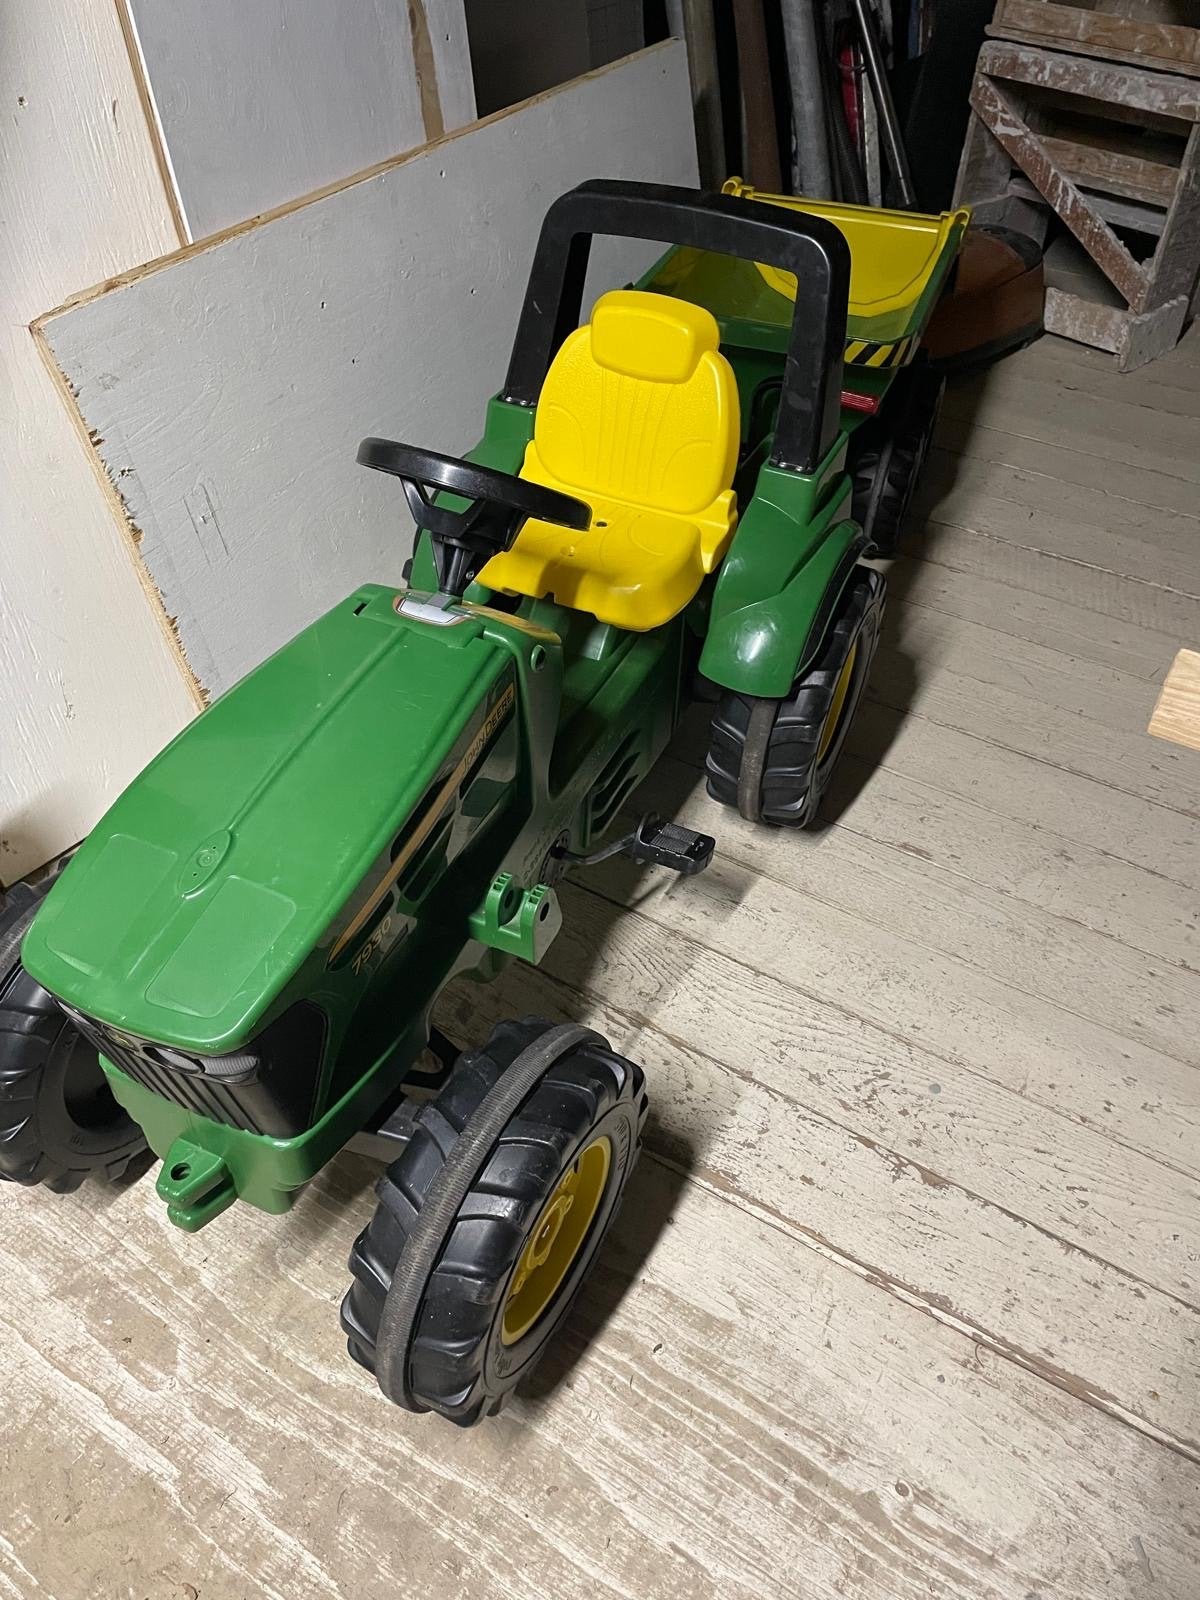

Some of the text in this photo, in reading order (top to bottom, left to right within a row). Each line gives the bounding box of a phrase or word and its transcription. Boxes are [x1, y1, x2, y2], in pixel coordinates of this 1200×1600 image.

[463, 690, 512, 770] JOHN DEERE
[351, 916, 391, 976] 7930
